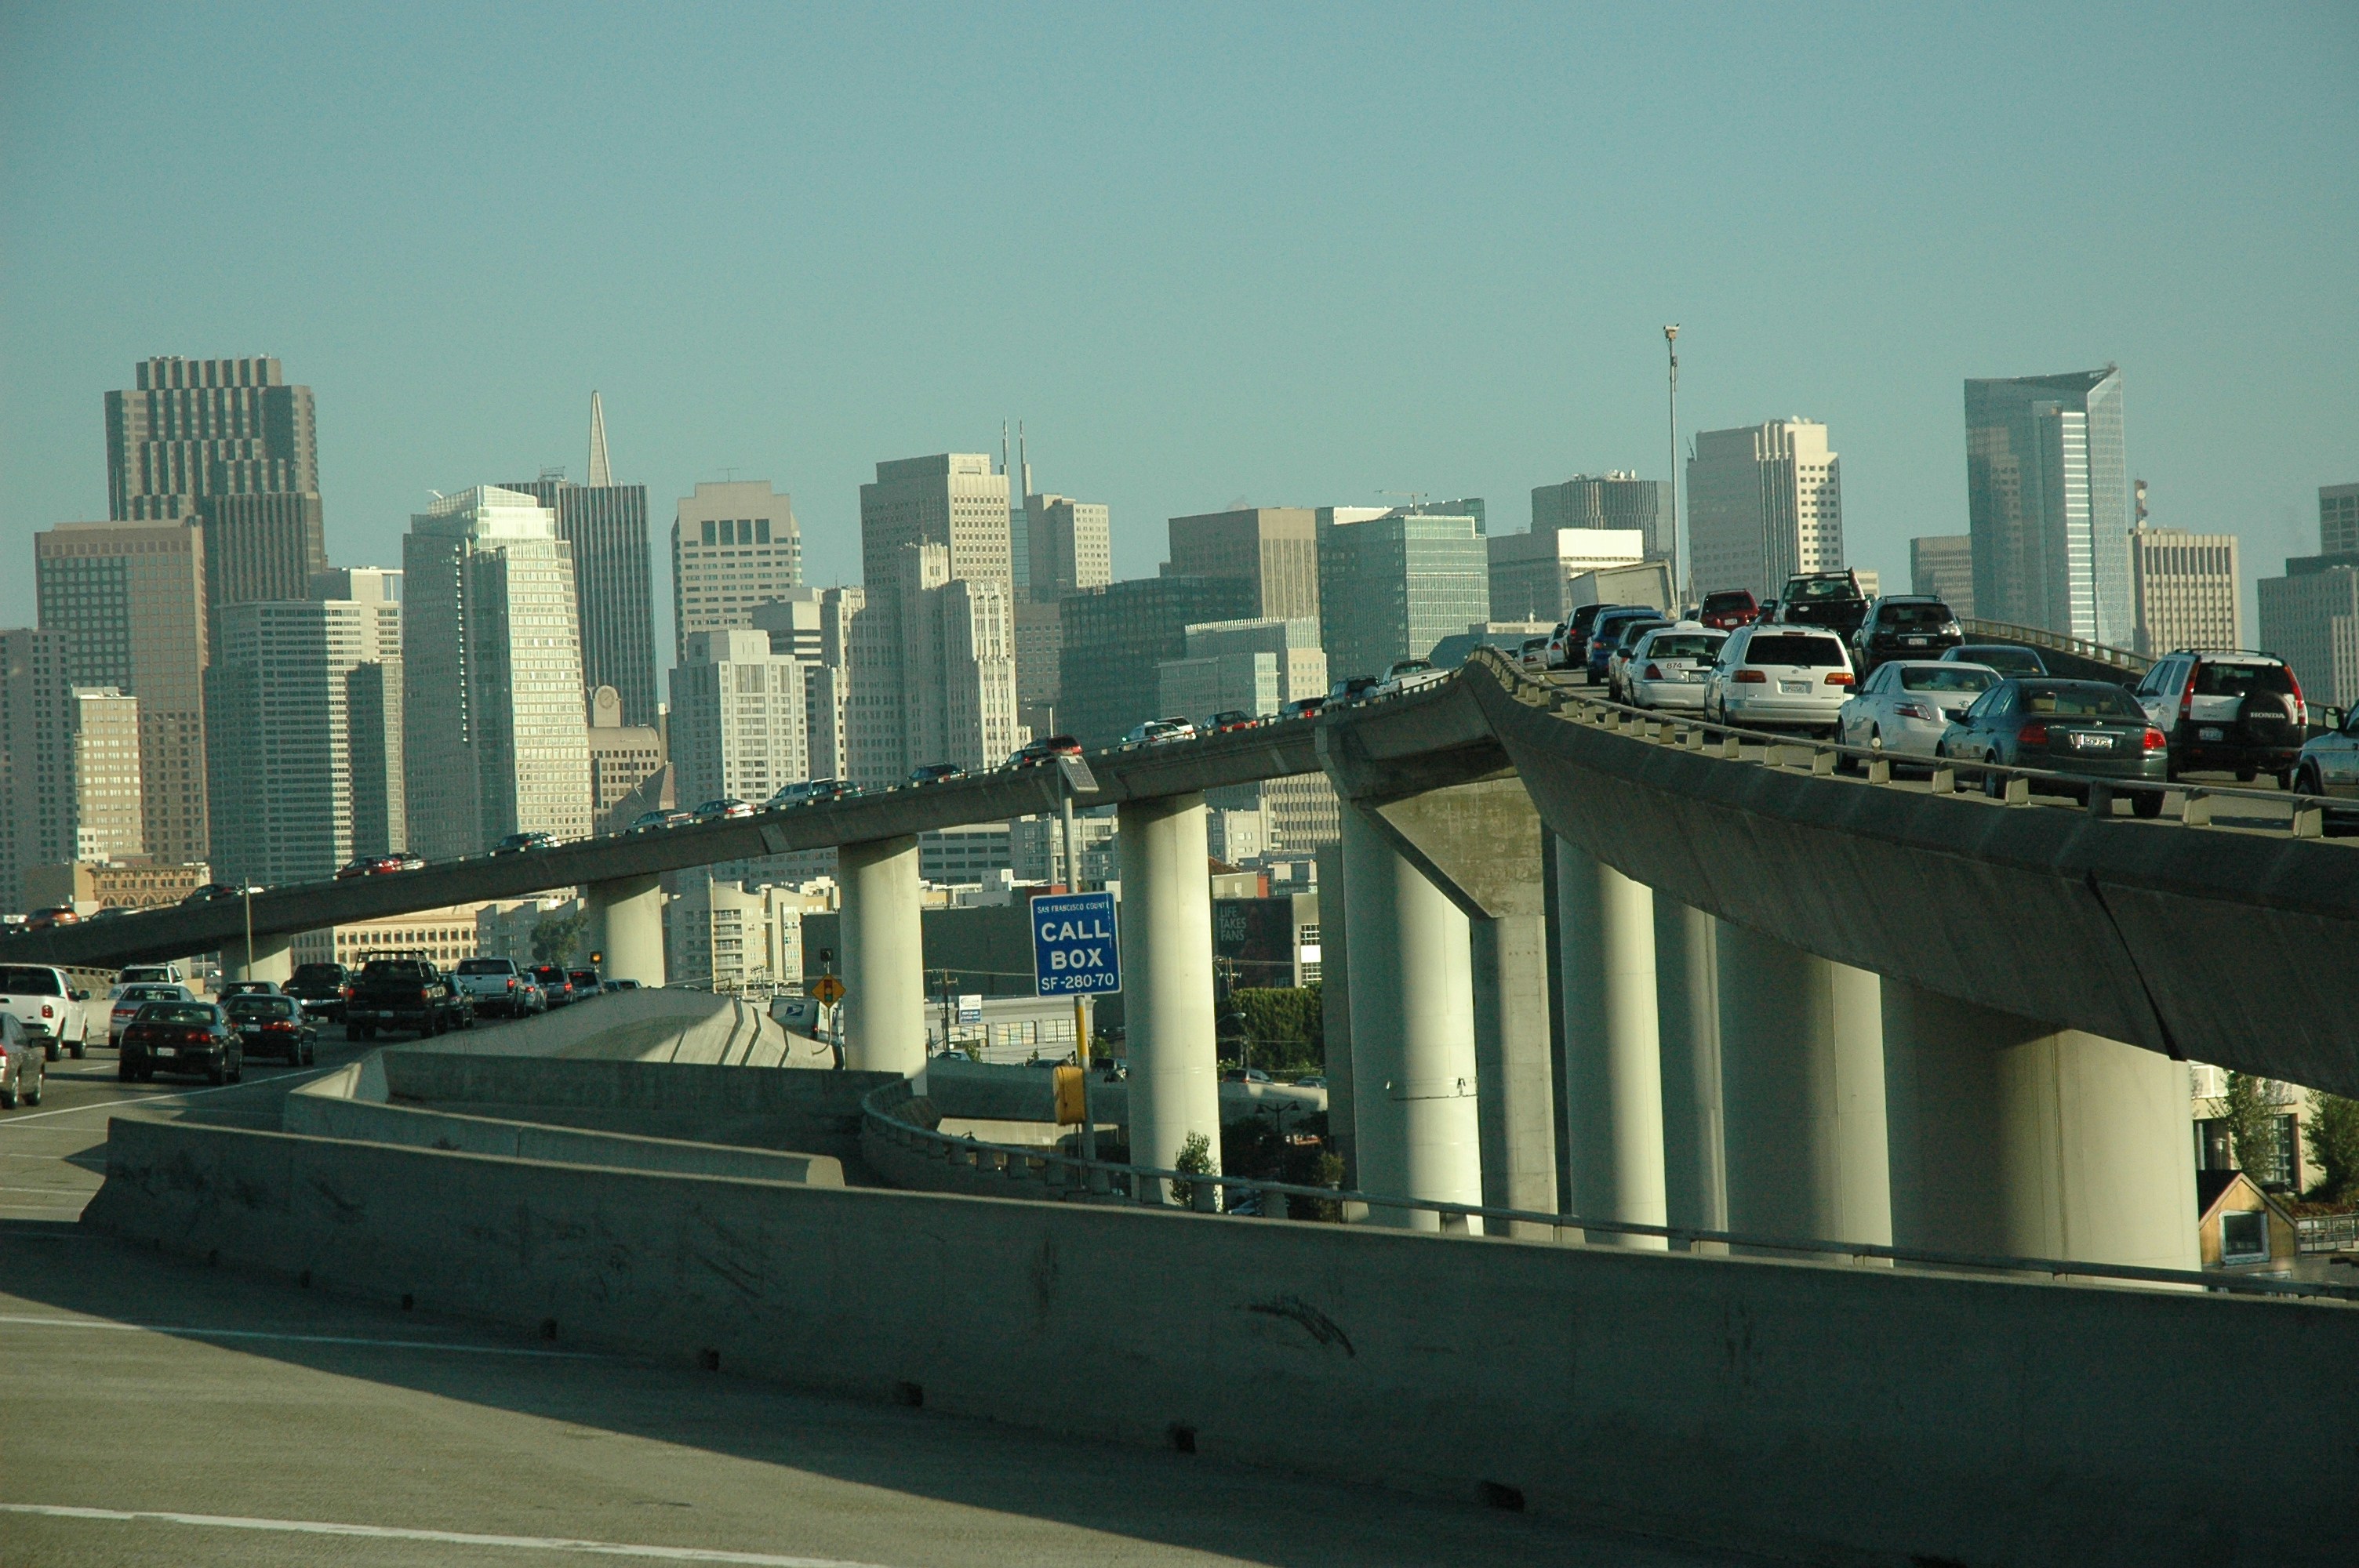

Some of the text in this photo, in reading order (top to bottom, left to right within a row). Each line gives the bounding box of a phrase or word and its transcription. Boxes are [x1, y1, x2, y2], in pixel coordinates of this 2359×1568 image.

[1051, 903, 1084, 913] FRANCISCO
[1086, 901, 1109, 910] COUNTY
[1219, 906, 1237, 917] LIFE
[1219, 917, 1247, 929] TAKES
[1041, 920, 1110, 942] CALL
[1220, 929, 1245, 941] FANS
[1051, 948, 1103, 970] BOX
